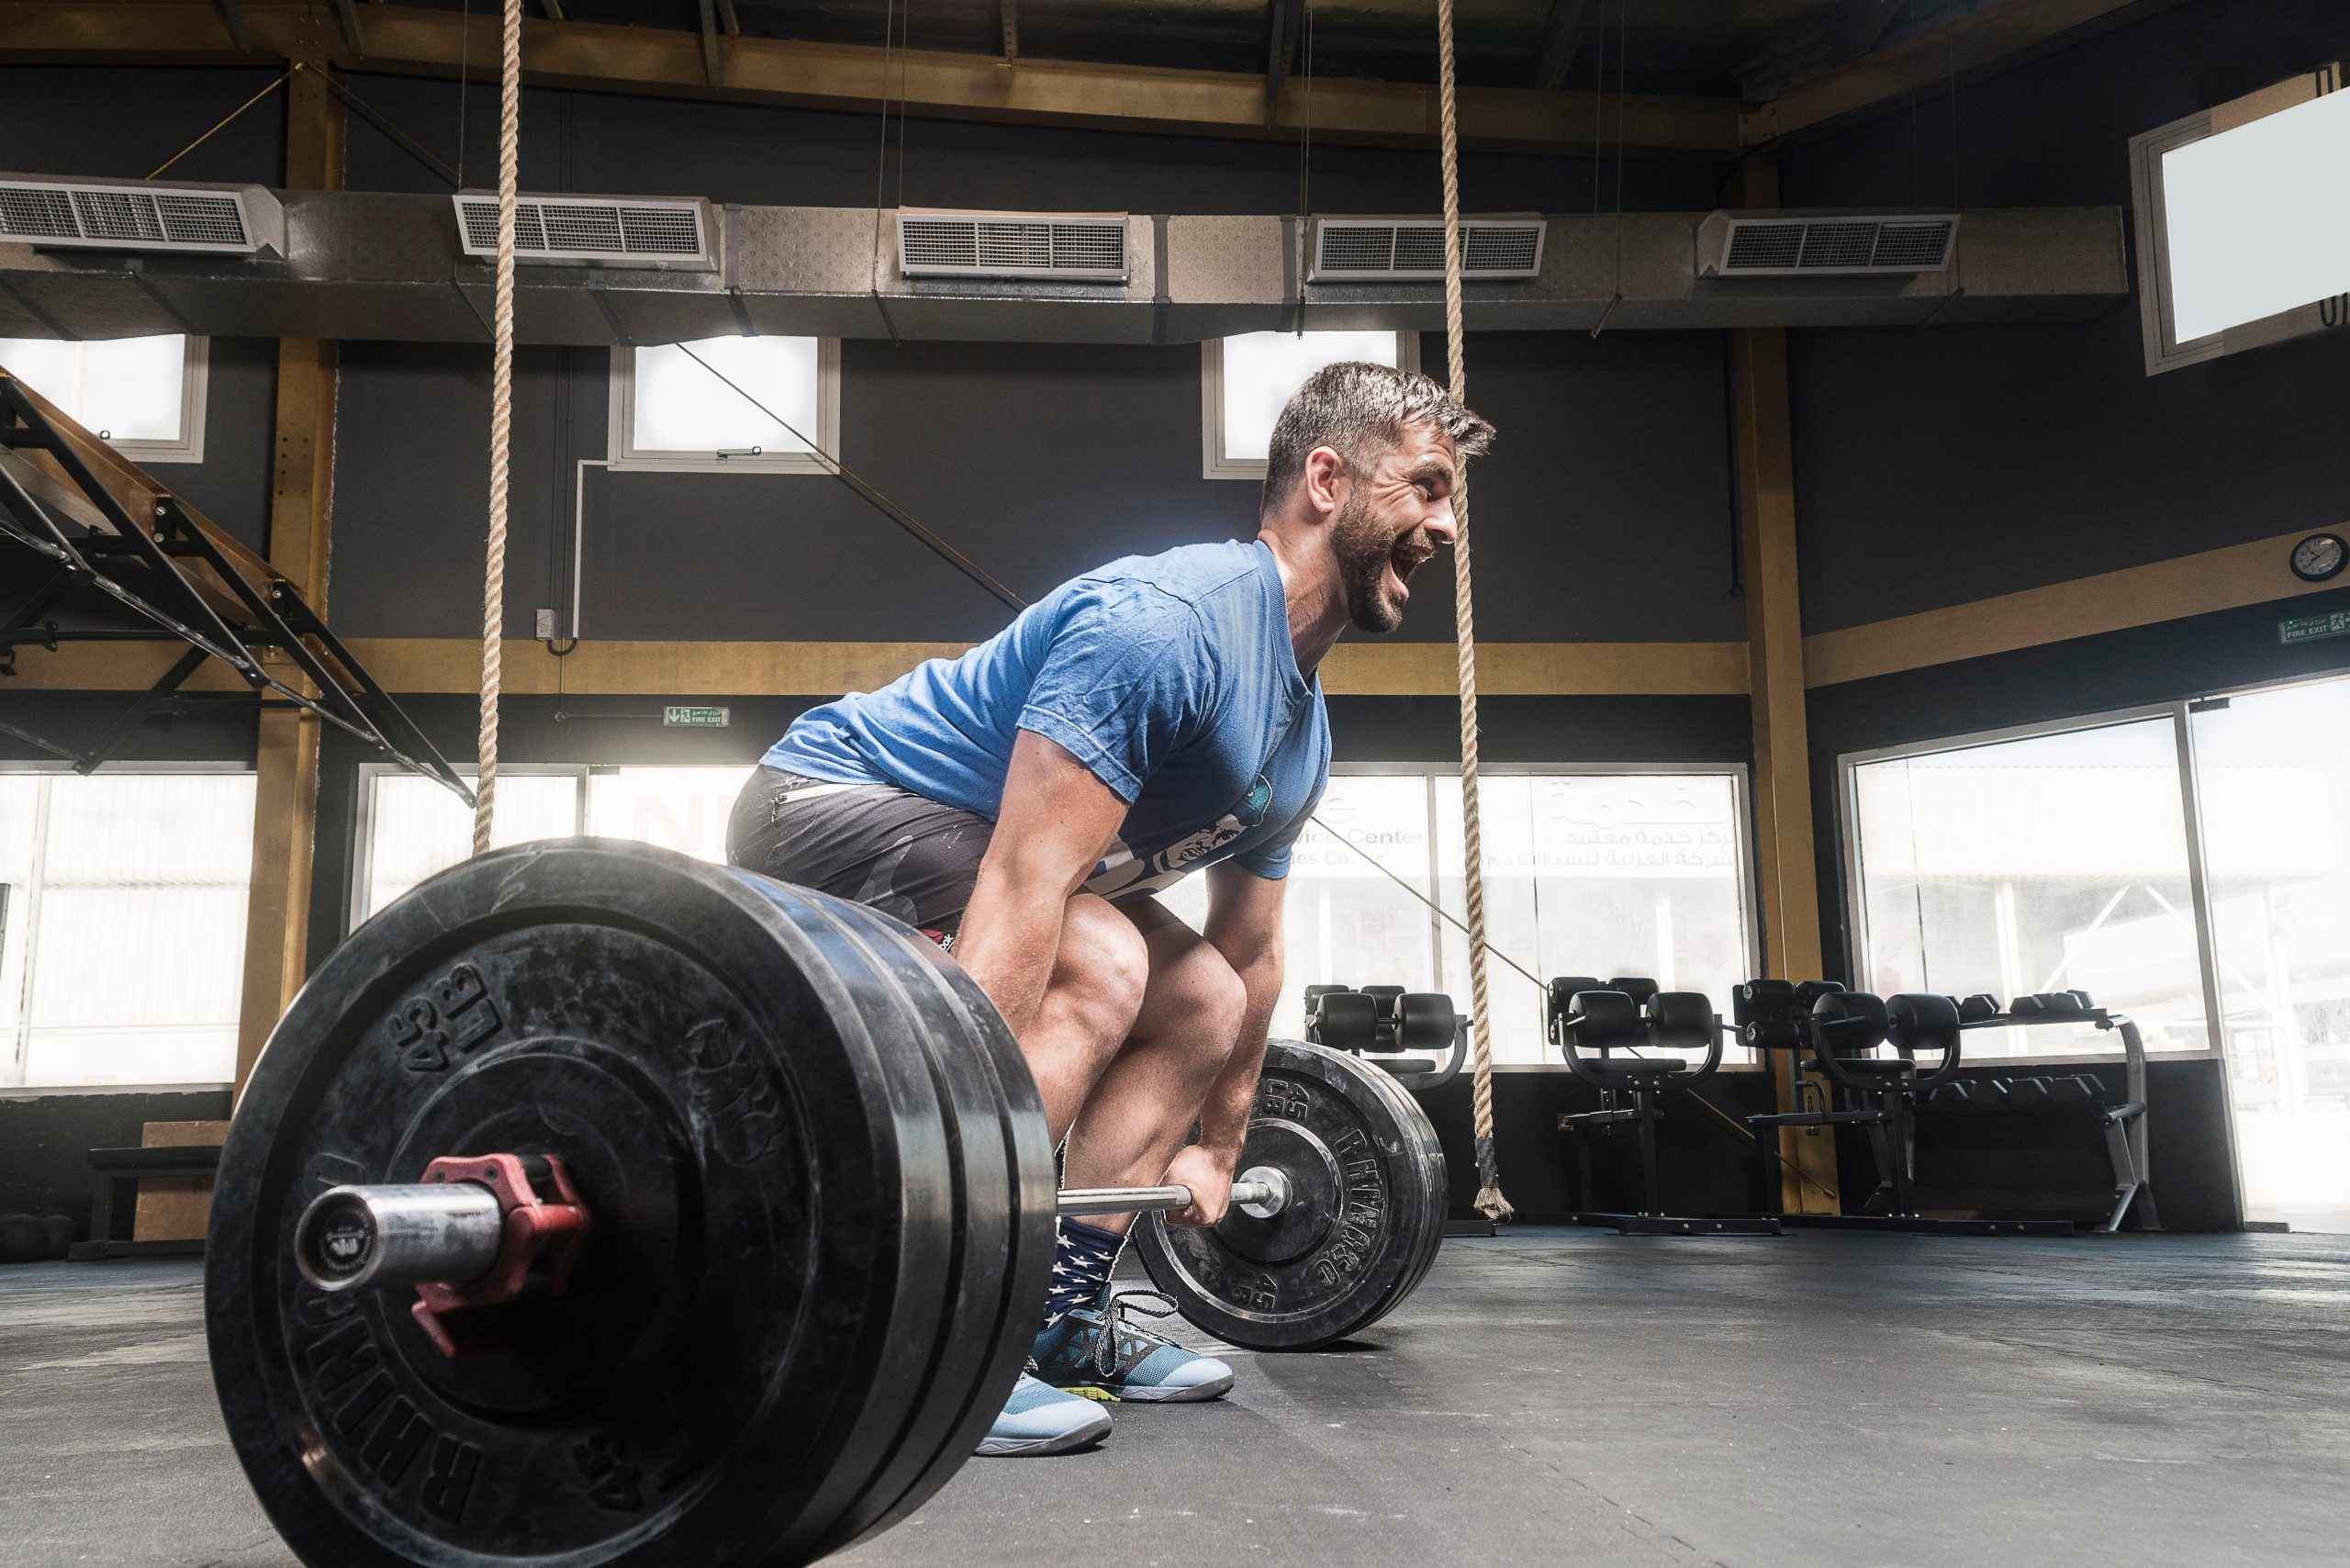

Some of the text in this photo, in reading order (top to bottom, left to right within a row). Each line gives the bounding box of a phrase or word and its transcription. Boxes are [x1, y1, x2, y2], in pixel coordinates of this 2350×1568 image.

[1347, 829, 1425, 845] Center
[383, 996, 450, 1072] 45
[428, 961, 504, 1055] LB
[1284, 1082, 1311, 1120] 45
